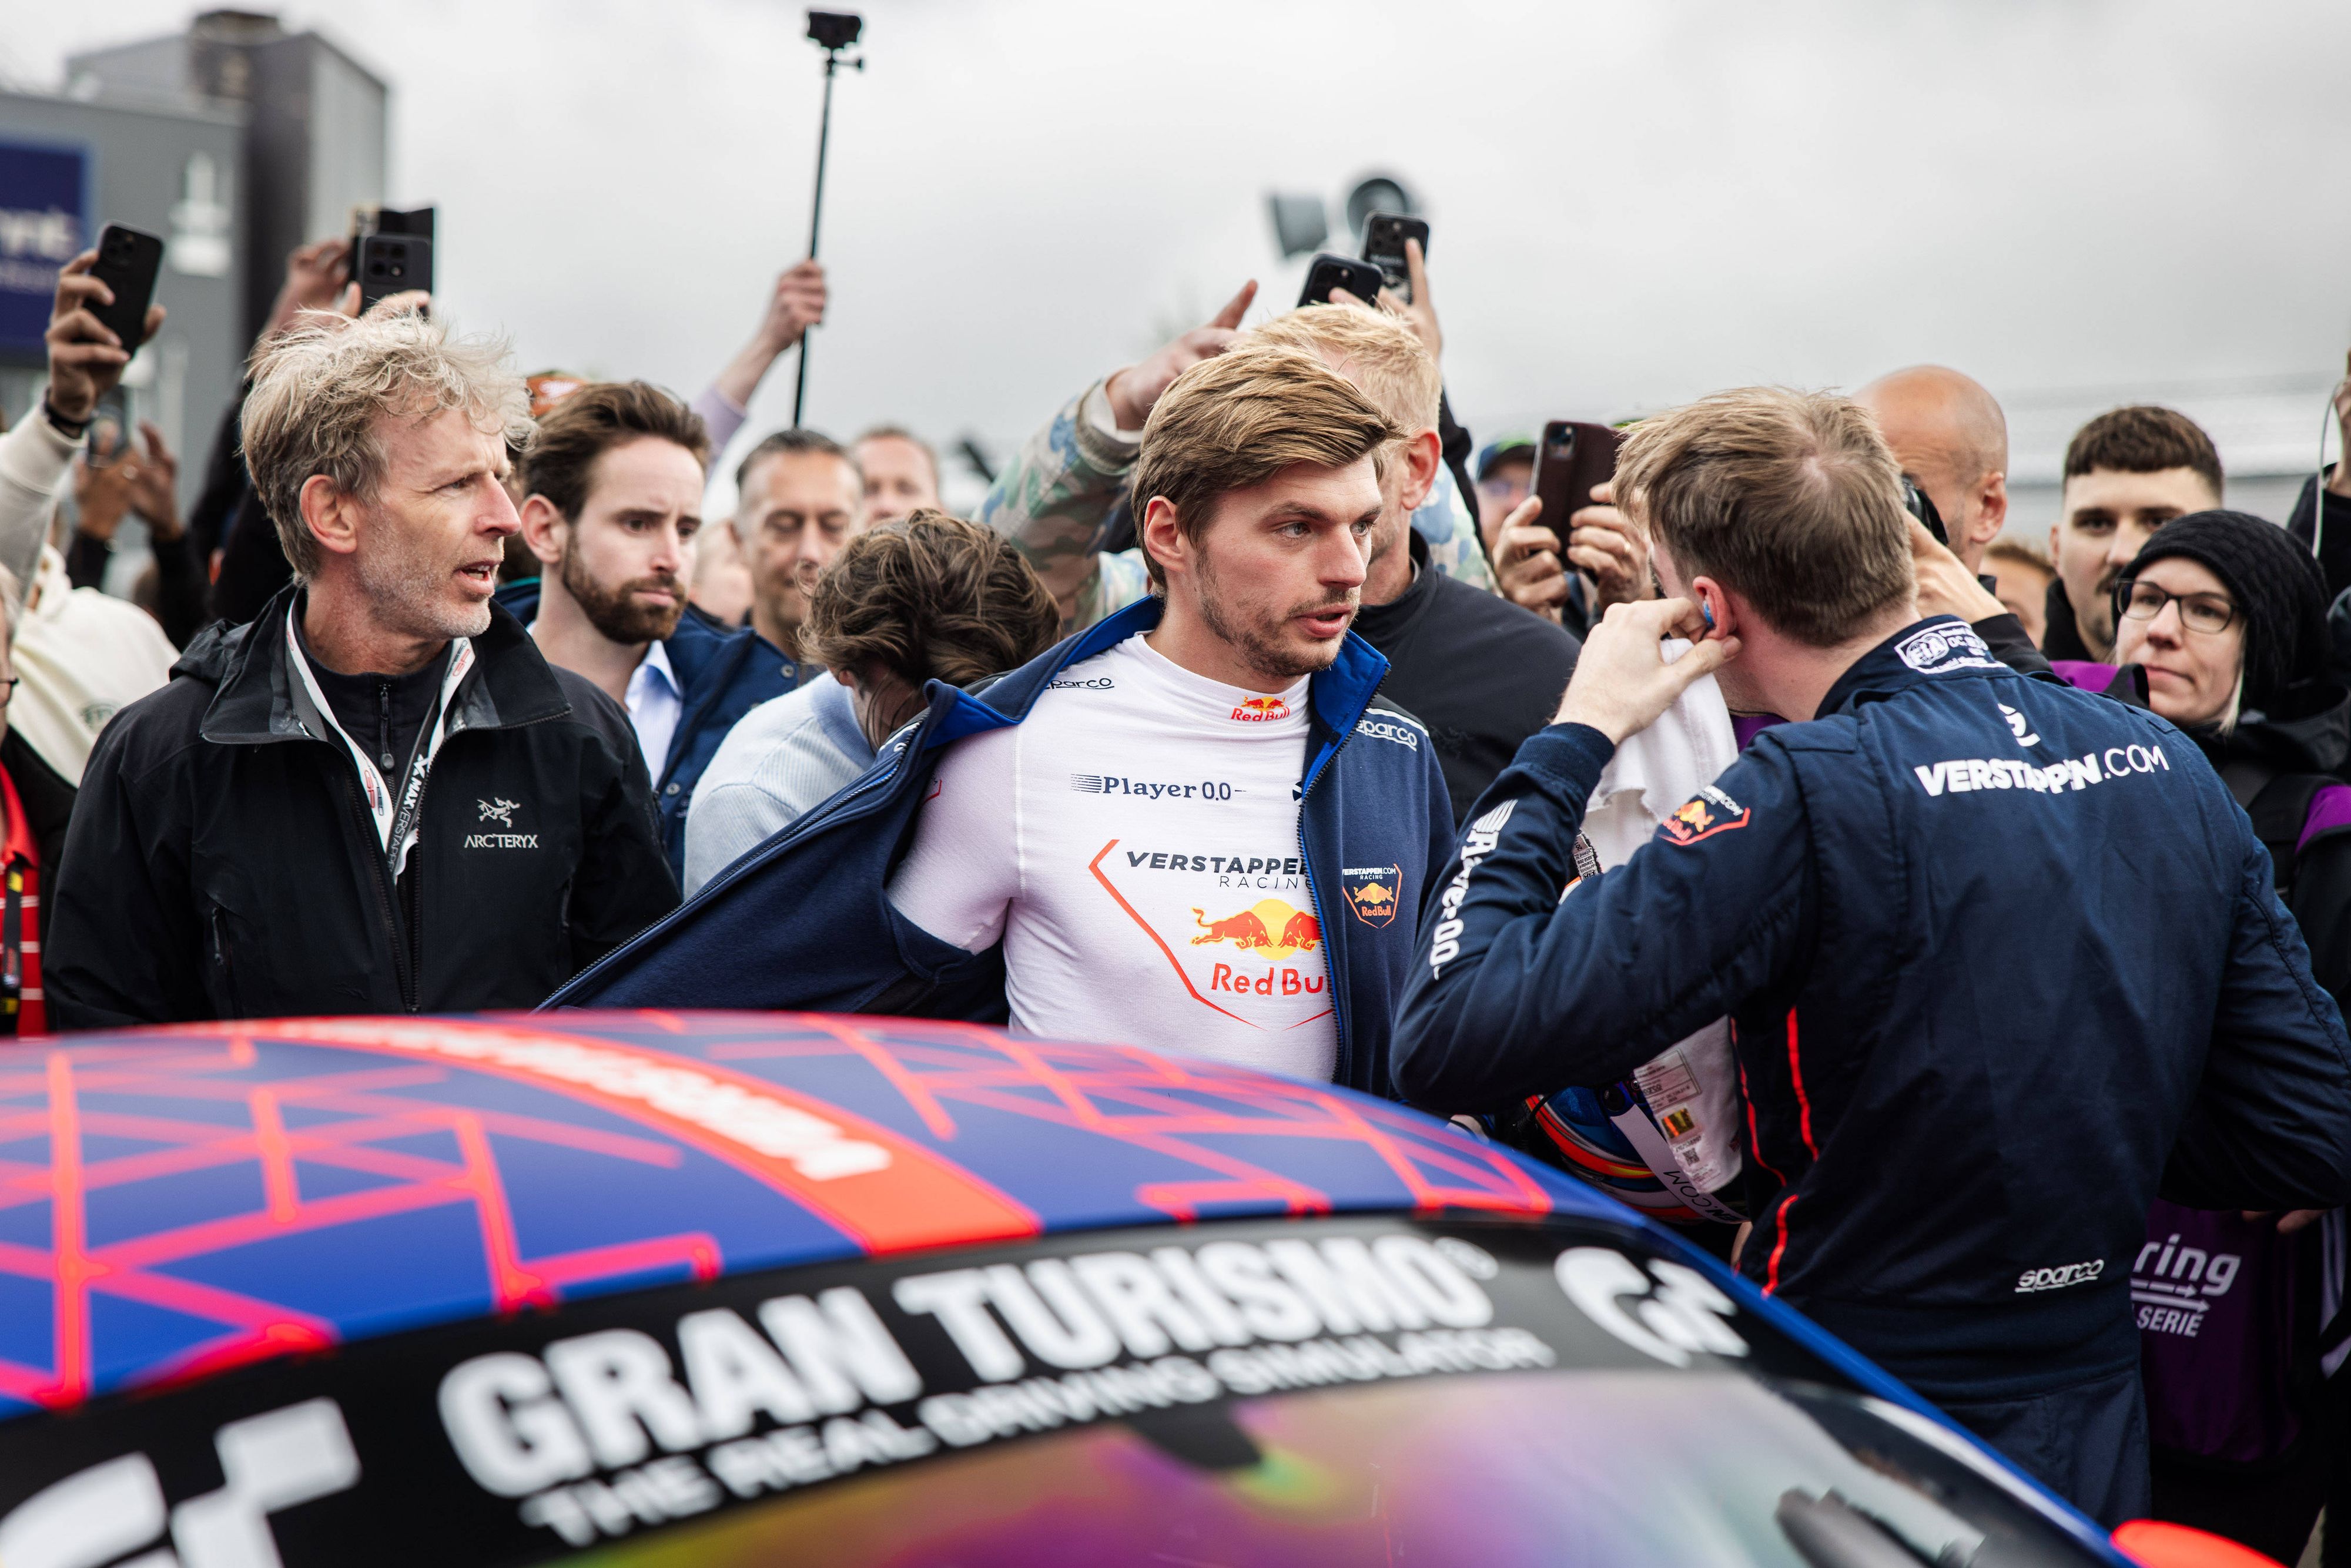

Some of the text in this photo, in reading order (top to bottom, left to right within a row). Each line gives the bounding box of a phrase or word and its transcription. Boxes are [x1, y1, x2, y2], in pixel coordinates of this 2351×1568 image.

[1046, 678, 1111, 689] parco
[1231, 707, 1290, 722] Red Bull
[1103, 776, 1197, 800] Player
[1361, 905, 1391, 917] Red Bull
[1211, 963, 1332, 996] Red Bu
[2017, 1259, 2105, 1292] sparco
[2132, 1234, 2242, 1296] ring
[438, 1286, 923, 1497] GRAN
[893, 1234, 1493, 1383] TURISMO
[520, 1326, 1557, 1548] THE REAL DRIVING SIMULATOR
